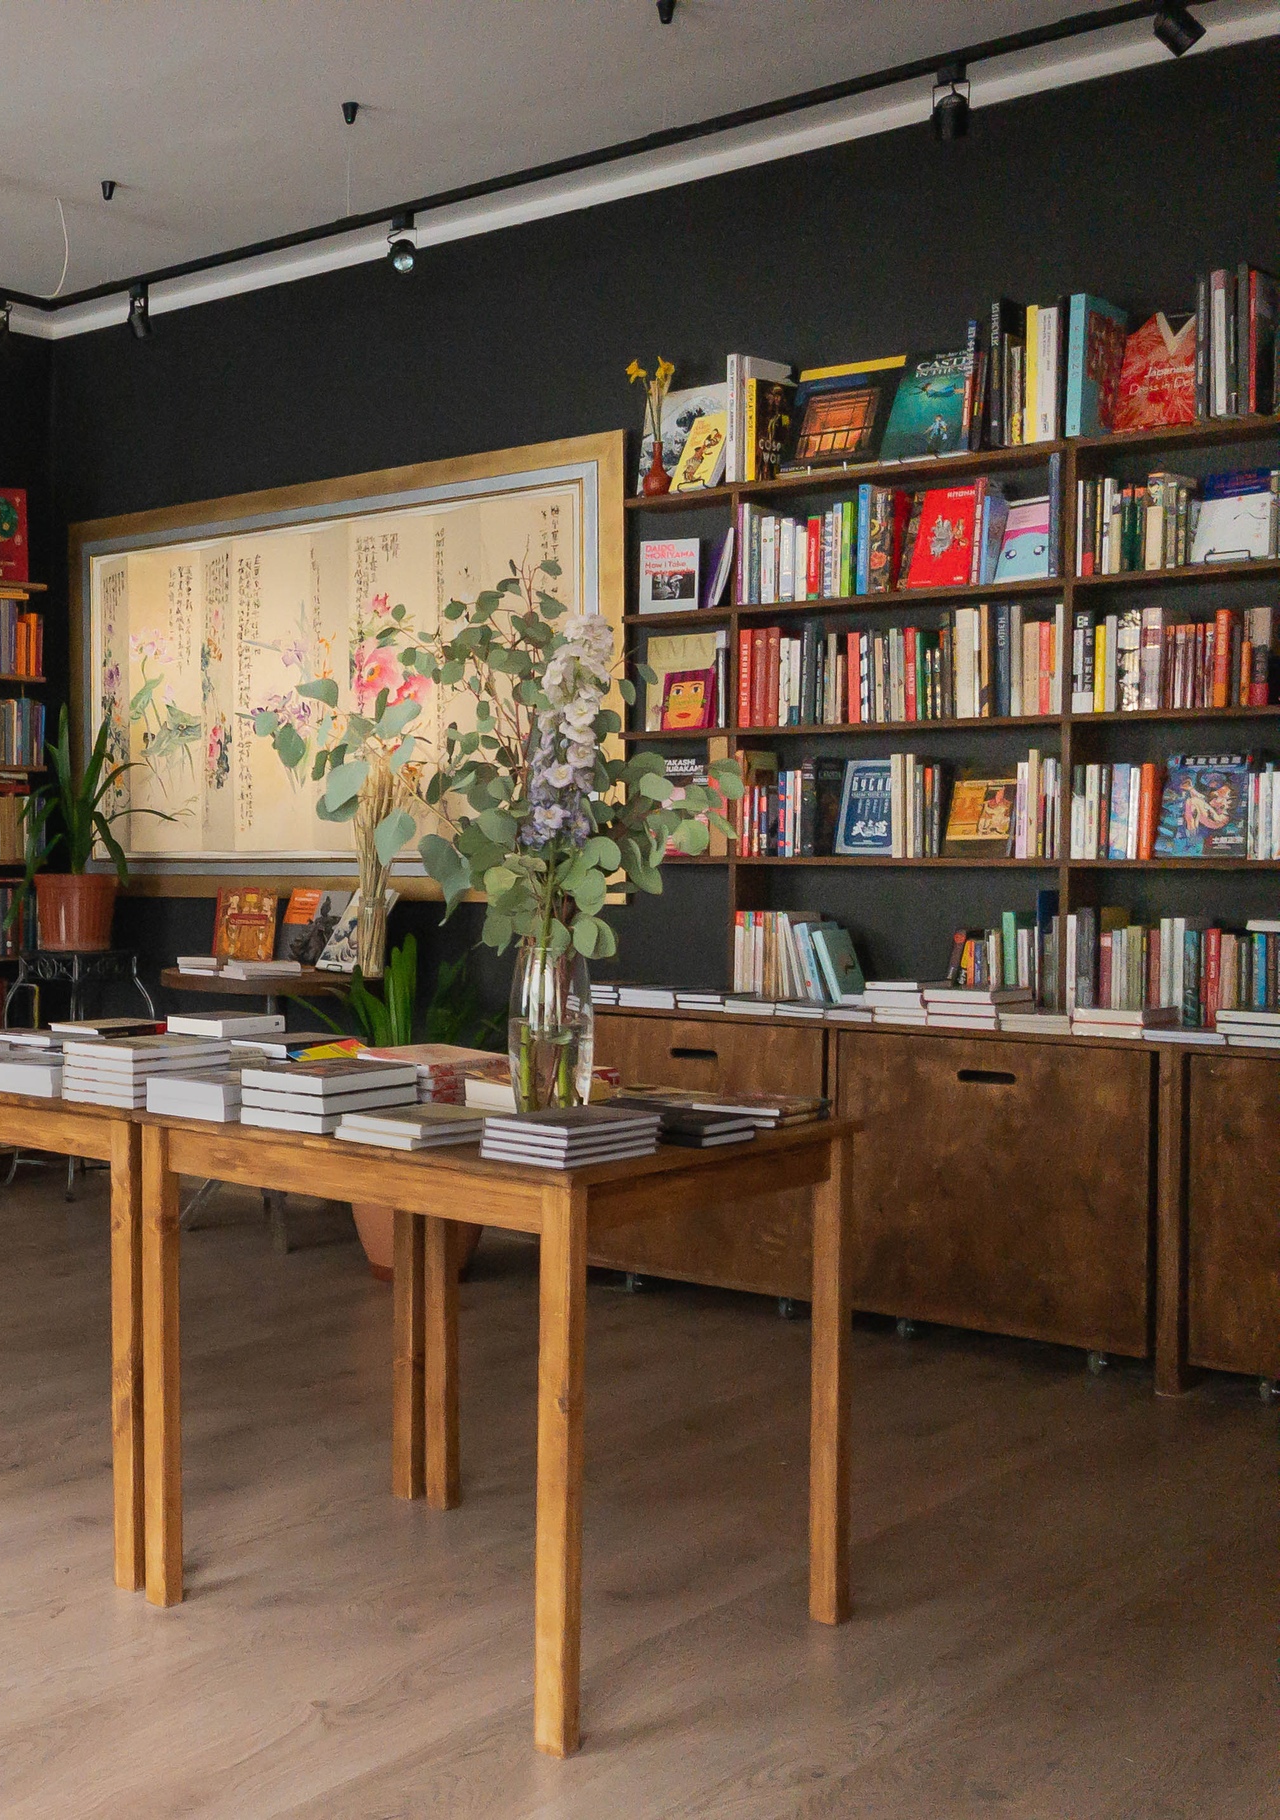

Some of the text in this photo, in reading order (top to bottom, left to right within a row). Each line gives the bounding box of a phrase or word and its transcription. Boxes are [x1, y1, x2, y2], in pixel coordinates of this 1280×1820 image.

[947, 489, 976, 499] ЯПОНИ
[645, 544, 675, 552] DAIDO
[645, 551, 695, 560] MORIYAMA
[824, 512, 833, 598] МУРАКАМИ
[668, 560, 687, 568] Take
[664, 758, 696, 766] TAKASHI
